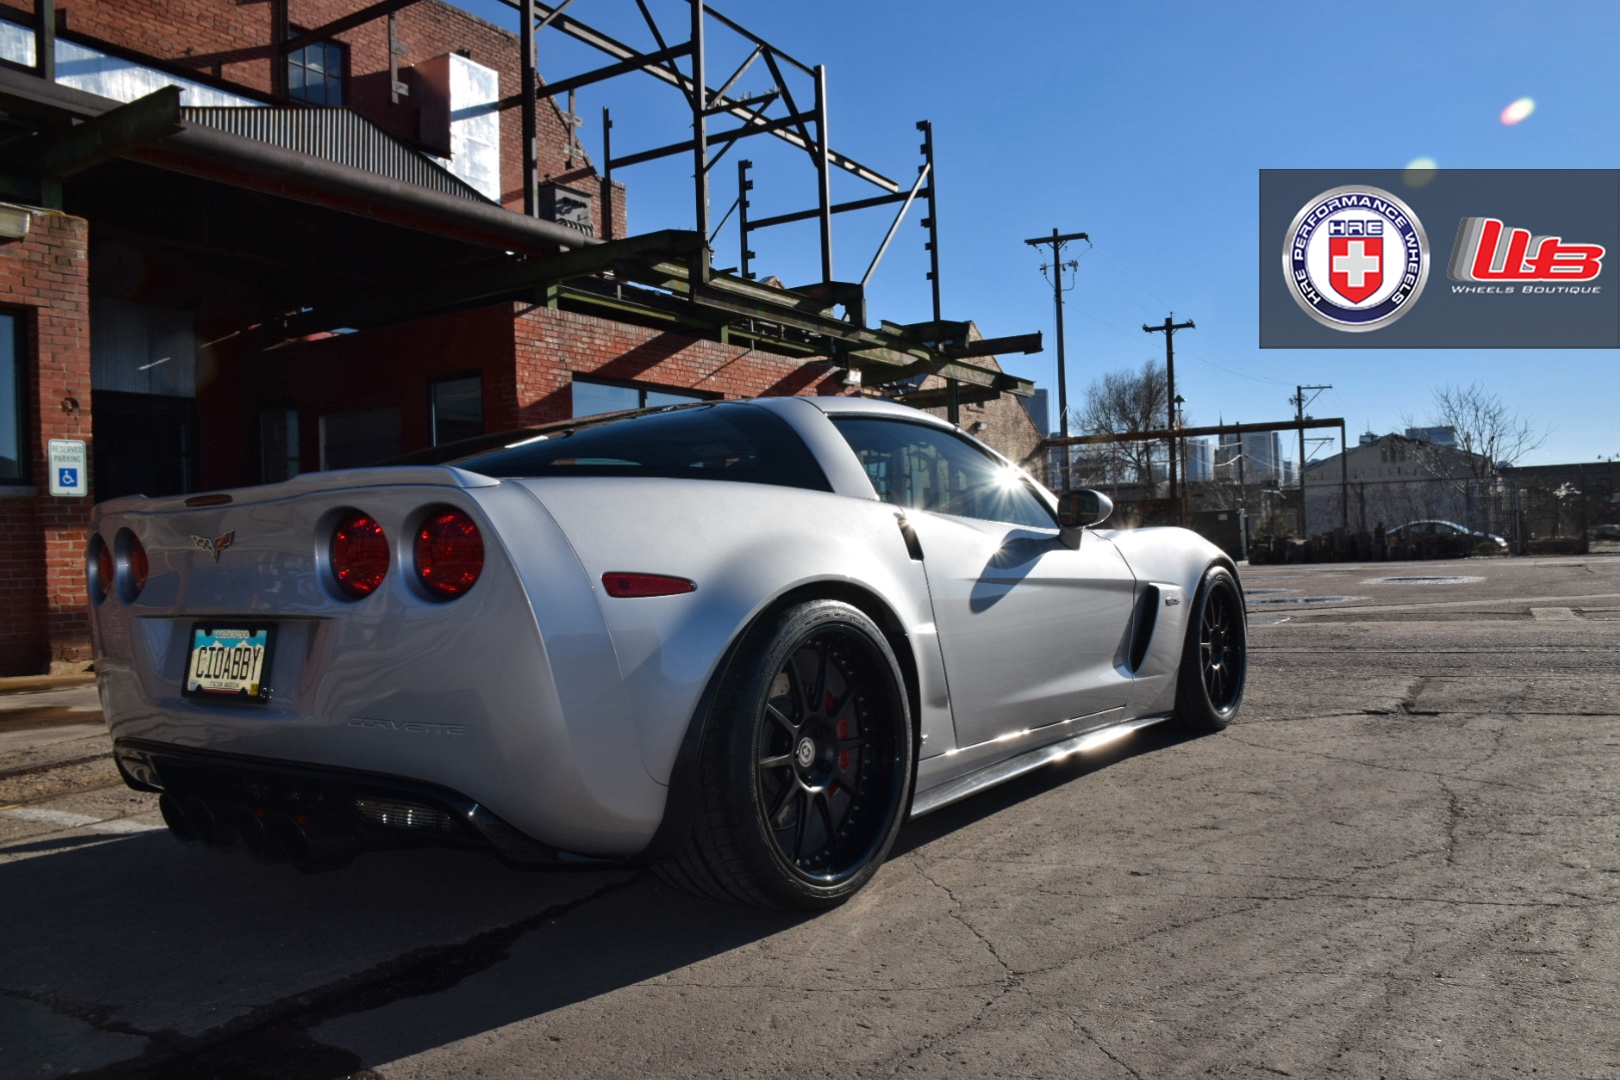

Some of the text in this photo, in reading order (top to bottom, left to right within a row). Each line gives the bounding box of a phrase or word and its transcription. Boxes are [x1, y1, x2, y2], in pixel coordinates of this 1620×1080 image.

[51, 446, 83, 454] RESERVED
[53, 455, 81, 463] PARKING
[347, 716, 467, 735] CORVETTE
